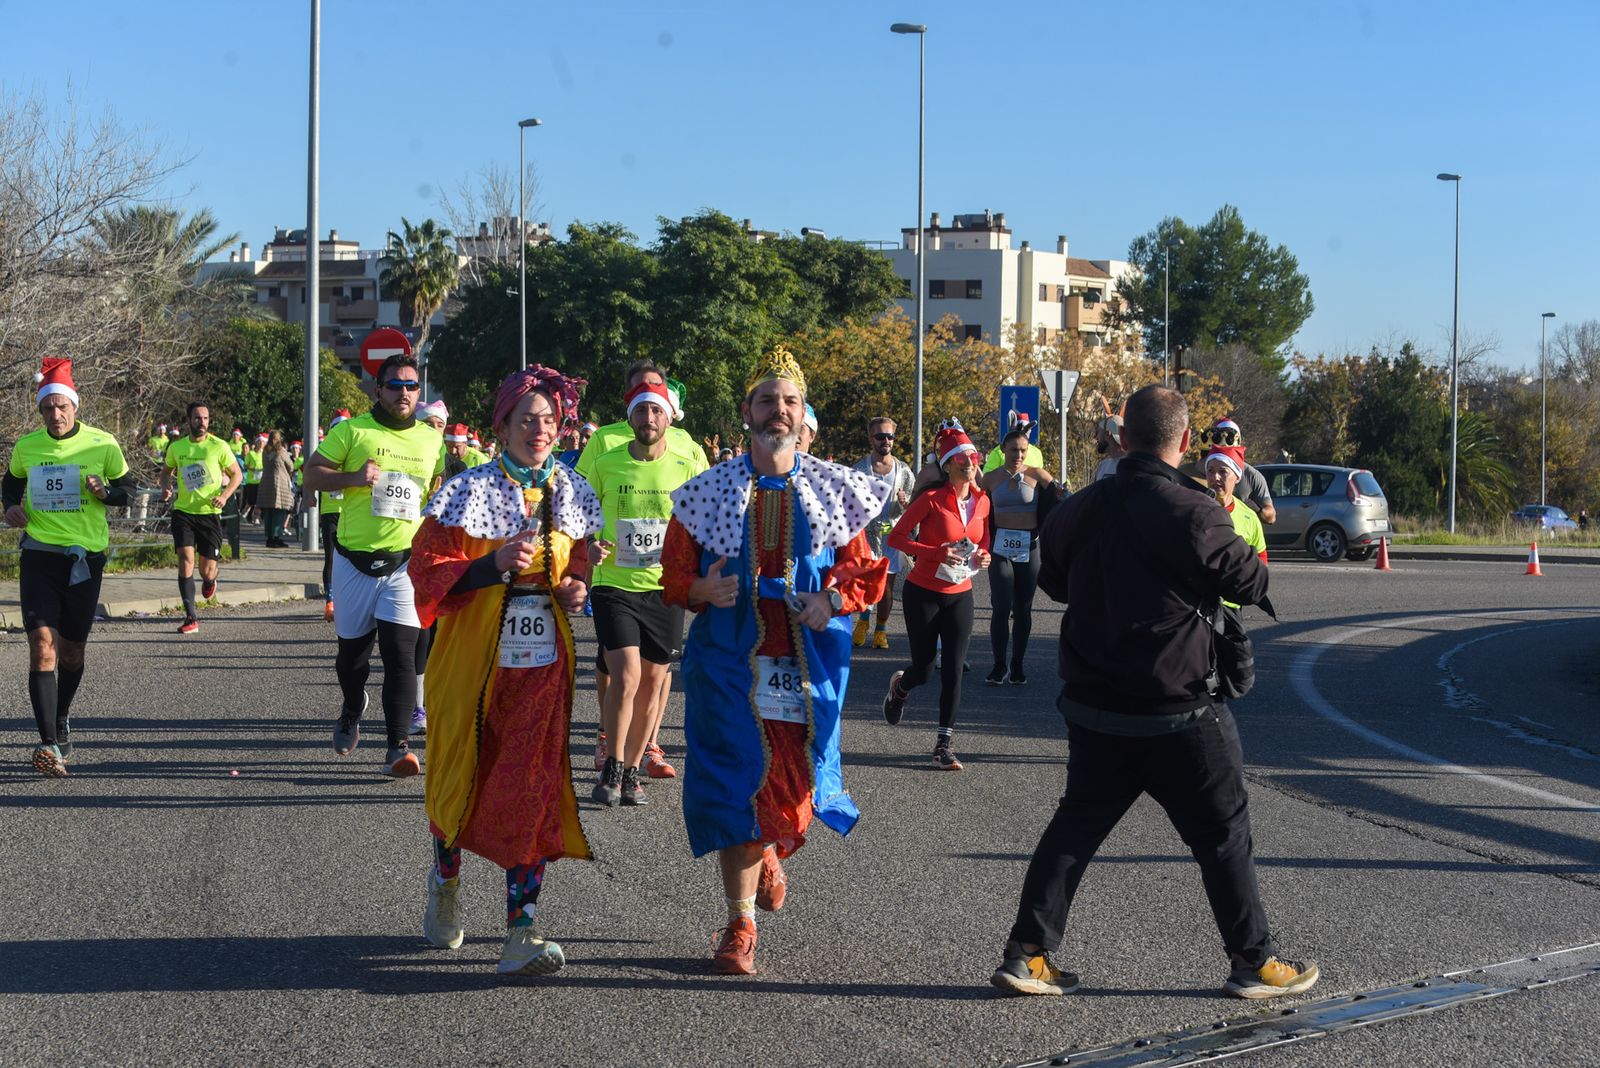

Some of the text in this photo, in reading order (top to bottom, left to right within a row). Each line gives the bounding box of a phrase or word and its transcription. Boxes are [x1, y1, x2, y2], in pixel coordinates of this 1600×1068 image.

[46, 478, 63, 491] 85
[386, 484, 411, 500] 596
[625, 532, 660, 547] 1361
[1003, 538, 1022, 549] 369
[507, 616, 545, 636] 186
[768, 672, 803, 693] 483
